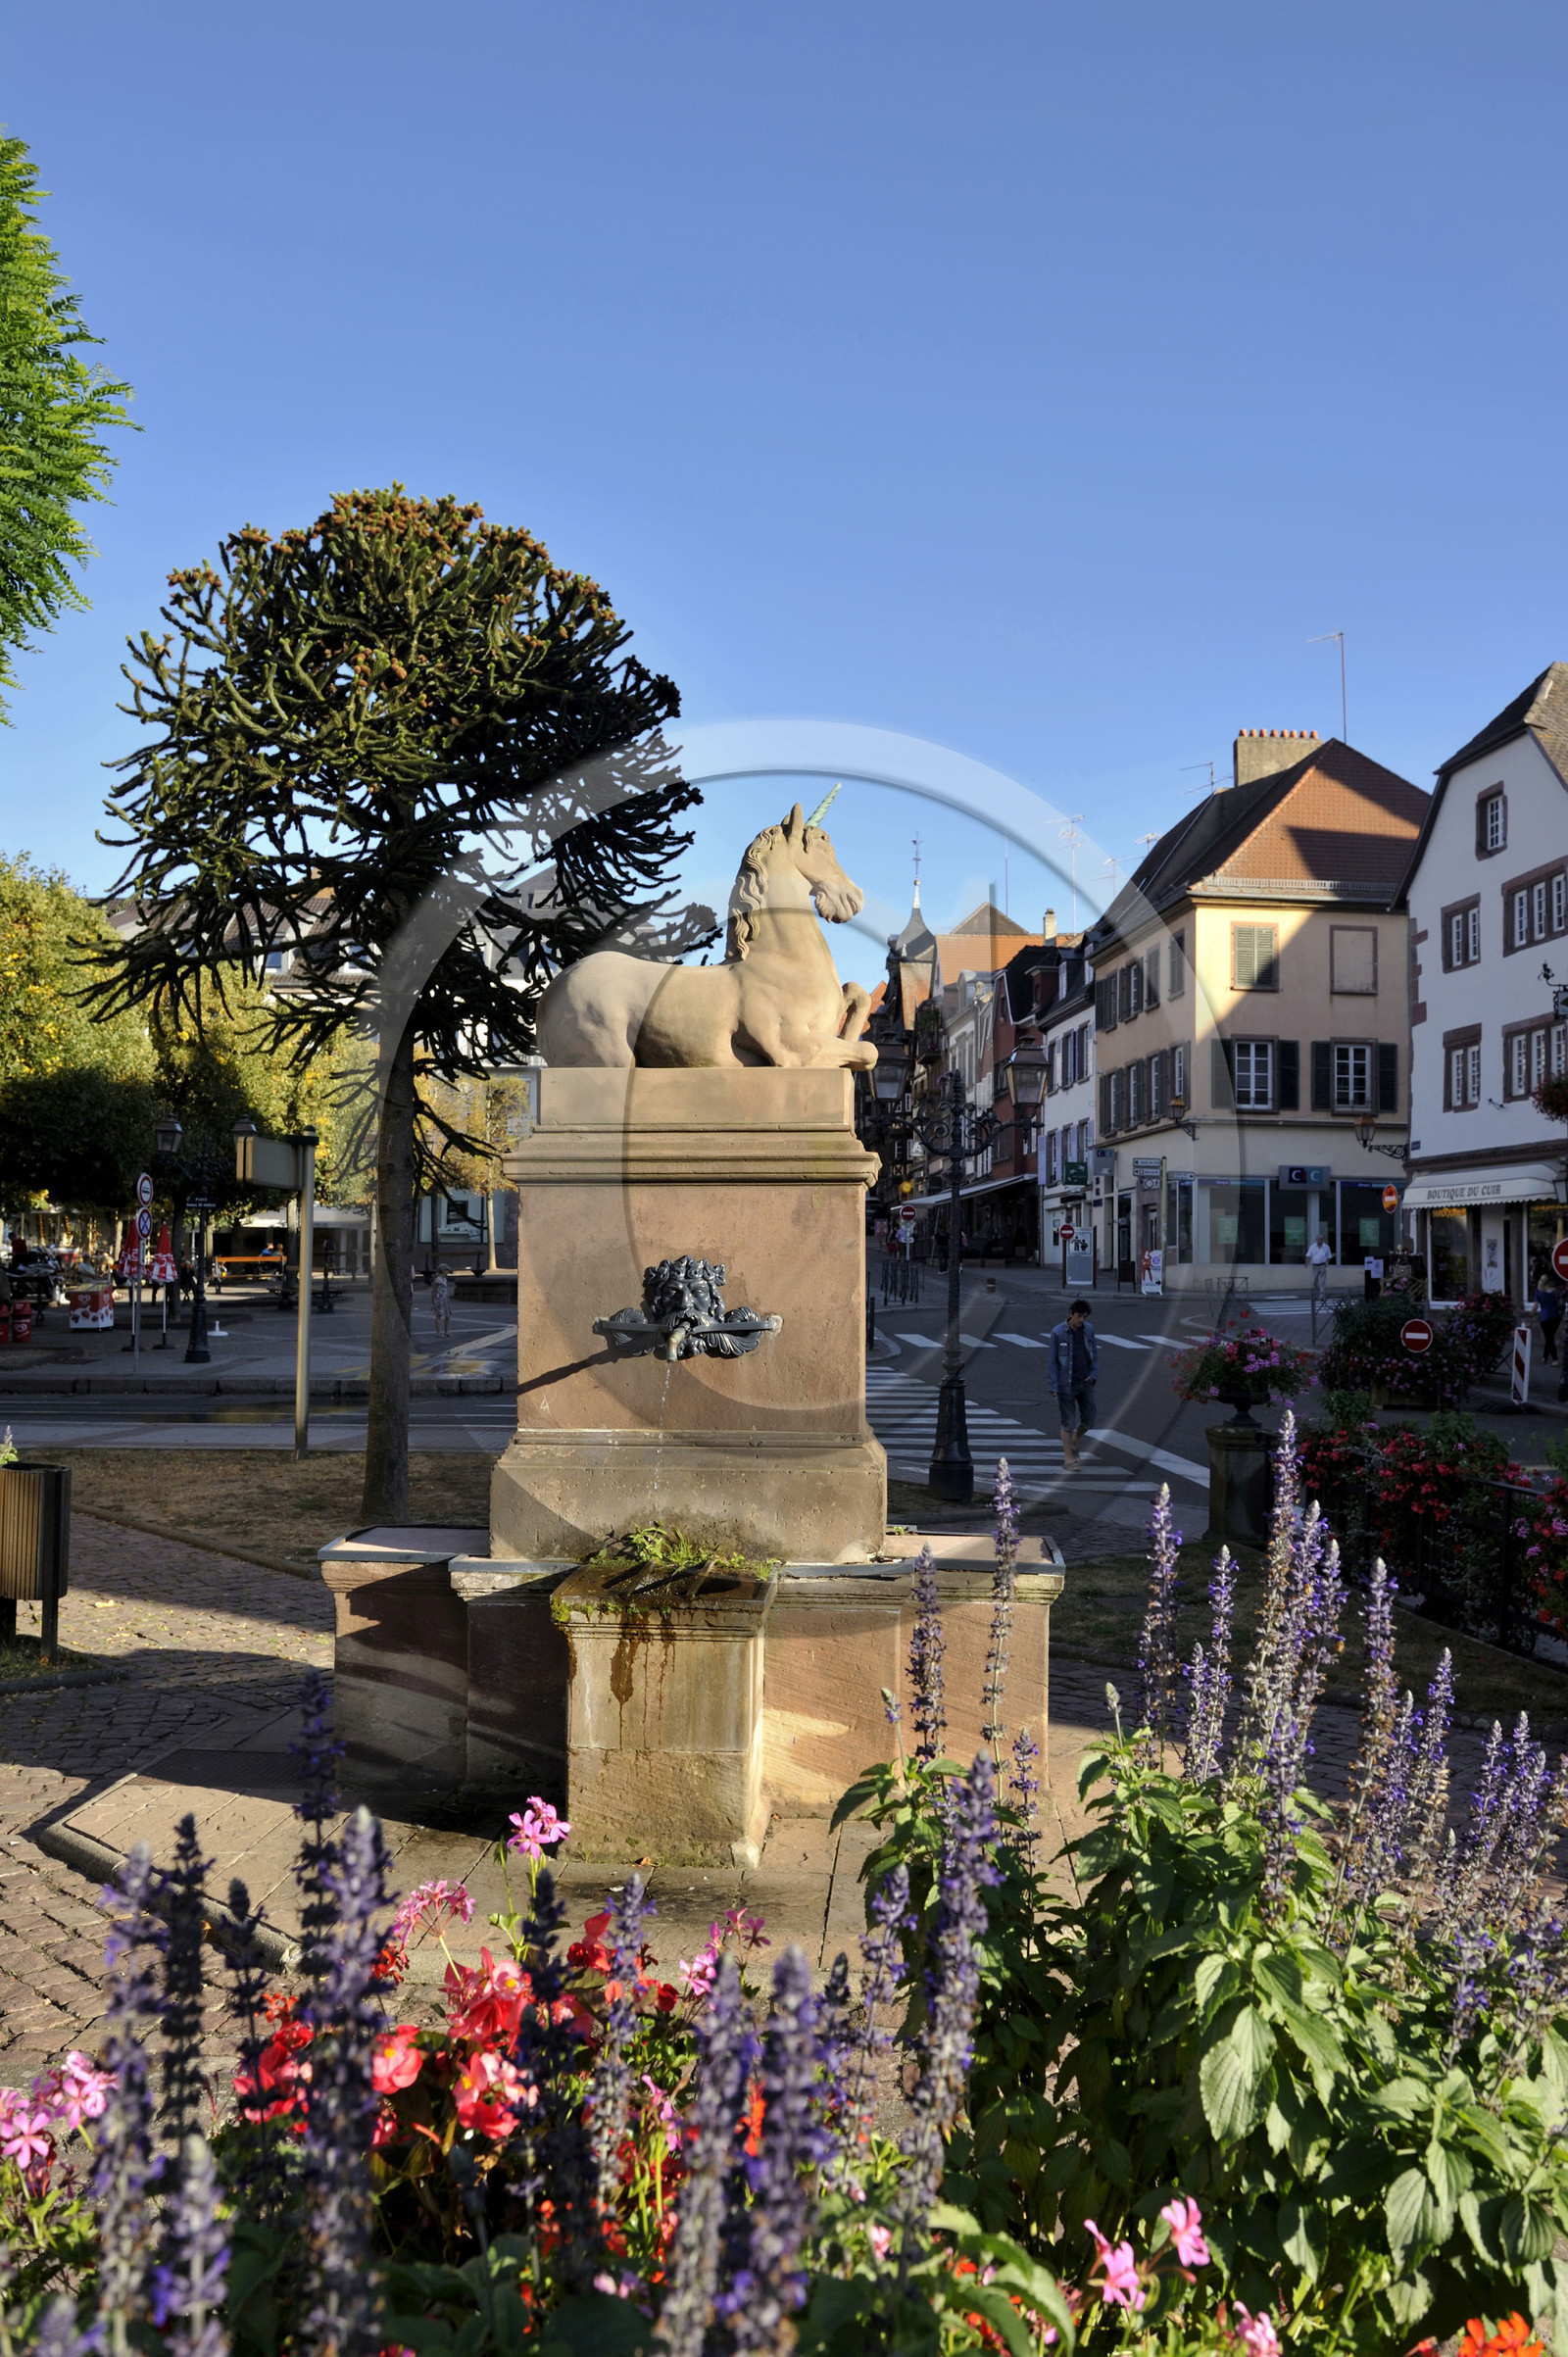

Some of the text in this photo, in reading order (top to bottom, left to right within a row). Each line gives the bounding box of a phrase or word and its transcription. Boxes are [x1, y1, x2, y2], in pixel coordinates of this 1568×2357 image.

[1427, 1184, 1501, 1200] BOUTIQUE DU CUIR
